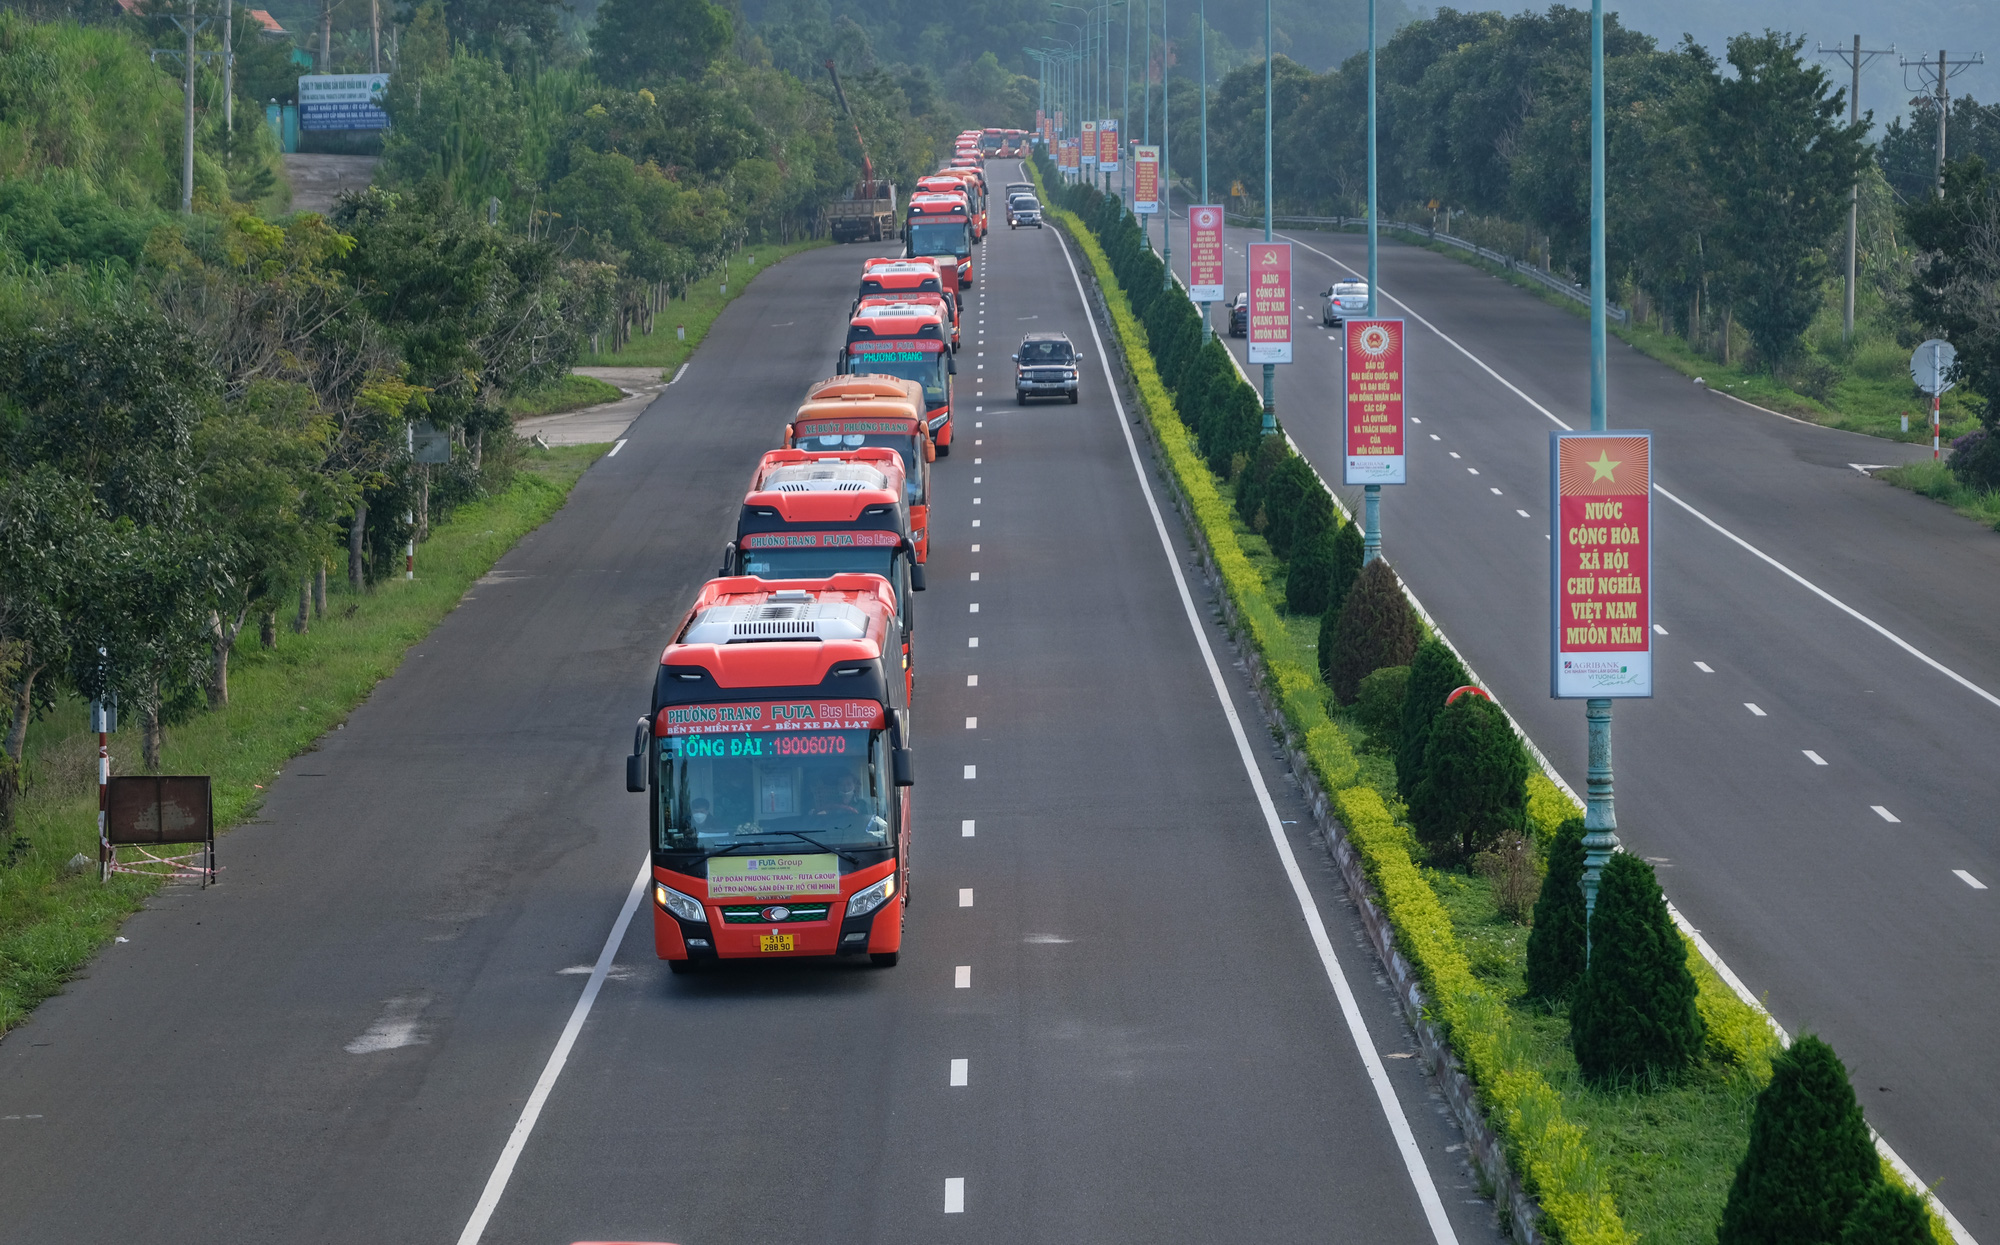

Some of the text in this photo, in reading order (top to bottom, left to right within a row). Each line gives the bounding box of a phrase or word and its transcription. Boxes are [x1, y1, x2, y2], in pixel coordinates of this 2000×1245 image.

[1262, 272, 1278, 284] ĐẢNG
[1256, 285, 1285, 300] CỘNG SẢN
[1256, 300, 1285, 314] VIỆT NAM
[1253, 316, 1288, 328] QUANG VINH
[1254, 328, 1287, 339] MUÔN NĂM
[898, 352, 922, 361] TRANG
[1364, 402, 1386, 412] CÁC CẤP
[1363, 413, 1369, 422] LÀ
[805, 421, 908, 434] XE BUÝT PHƯƠNG TRANG
[1354, 424, 1361, 433] VÀ
[1362, 424, 1378, 433] TRÁCH
[1370, 434, 1380, 443] CỦA
[1585, 499, 1622, 520] NƯỚC
[751, 534, 897, 547] PHƯƠNG TRANG FUTA Bus Lines
[1569, 523, 1639, 548] CỘNG HÒA
[1580, 548, 1628, 572] XÃ HỘI
[1567, 573, 1641, 594] CHỦ NGHĨA
[1571, 599, 1637, 623] VIỆT NAM
[1567, 621, 1641, 645] MUÔN NĂM
[668, 703, 877, 724] PHƯƠNG TRANG FUTA Bus Lines
[667, 724, 686, 735] BẾN
[689, 725, 702, 733] XE
[704, 722, 727, 732] MIỀN
[732, 723, 752, 732] TÂY
[776, 719, 800, 730] BẾN
[823, 719, 843, 729] ĐÀ
[845, 720, 870, 730] LẠT
[731, 733, 763, 756] ĐÀI
[764, 943, 790, 951] 288.90
